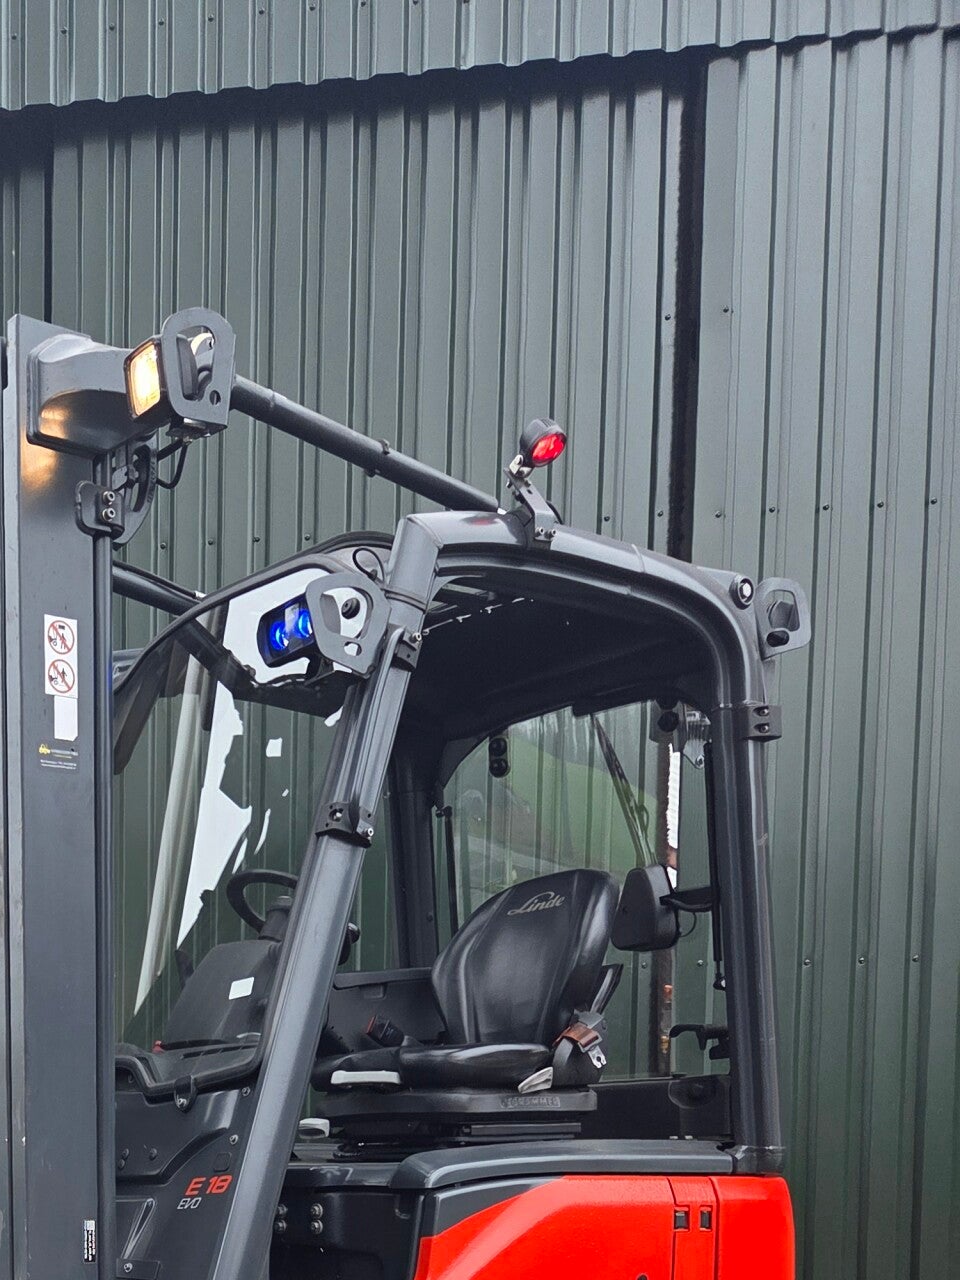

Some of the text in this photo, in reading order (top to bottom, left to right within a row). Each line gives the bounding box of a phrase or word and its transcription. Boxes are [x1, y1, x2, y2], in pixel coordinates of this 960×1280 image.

[507, 891, 565, 916] Linde
[185, 1174, 233, 1195] E 18
[177, 1197, 202, 1210] EVO
